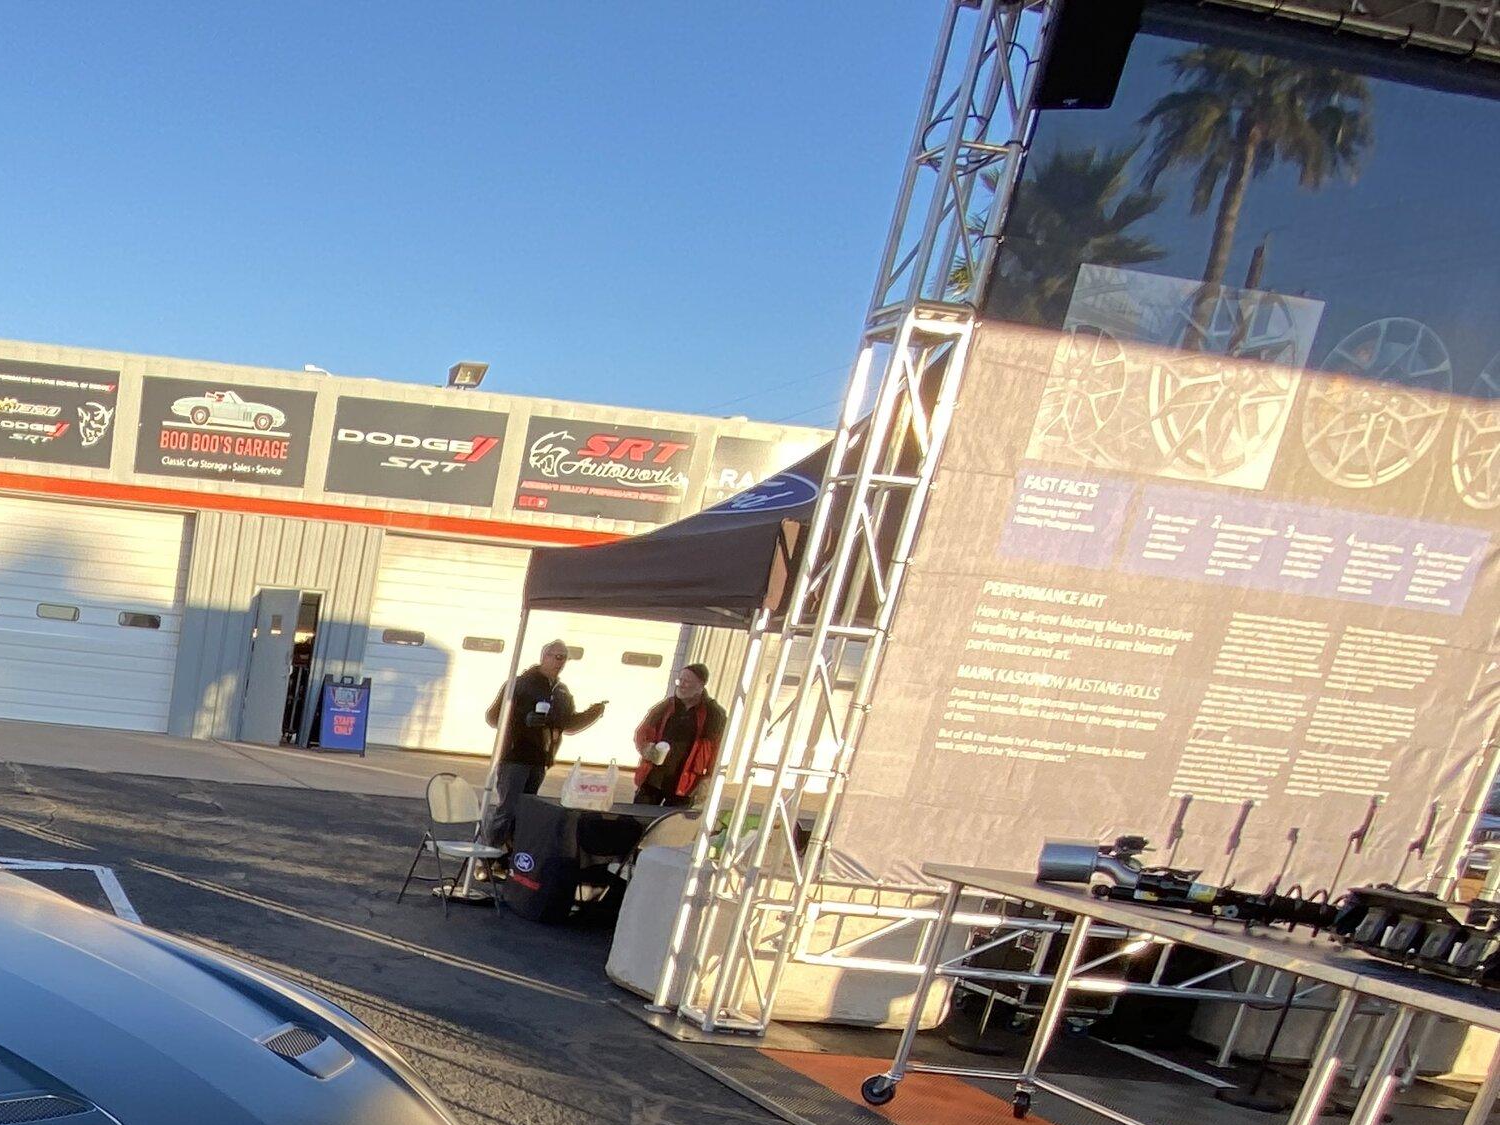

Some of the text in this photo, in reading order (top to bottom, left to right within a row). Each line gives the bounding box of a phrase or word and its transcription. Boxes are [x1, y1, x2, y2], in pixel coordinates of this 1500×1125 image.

[8, 432, 54, 444] SRT
[160, 430, 290, 459] BOO BOO'S GARAGE
[338, 428, 474, 453] DODGE
[577, 434, 689, 464] SRT
[161, 456, 283, 475] Classic Car Storage Sales Service
[380, 456, 465, 476] SRT
[560, 457, 690, 488] Autoworks
[1023, 474, 1100, 498] FAST FACTS
[982, 580, 1107, 608] PERFORMANCE ART
[957, 664, 996, 681] MARK
[1065, 677, 1123, 696] MUSTANG
[1123, 683, 1161, 700] ROLLS
[588, 785, 608, 793] CVS
